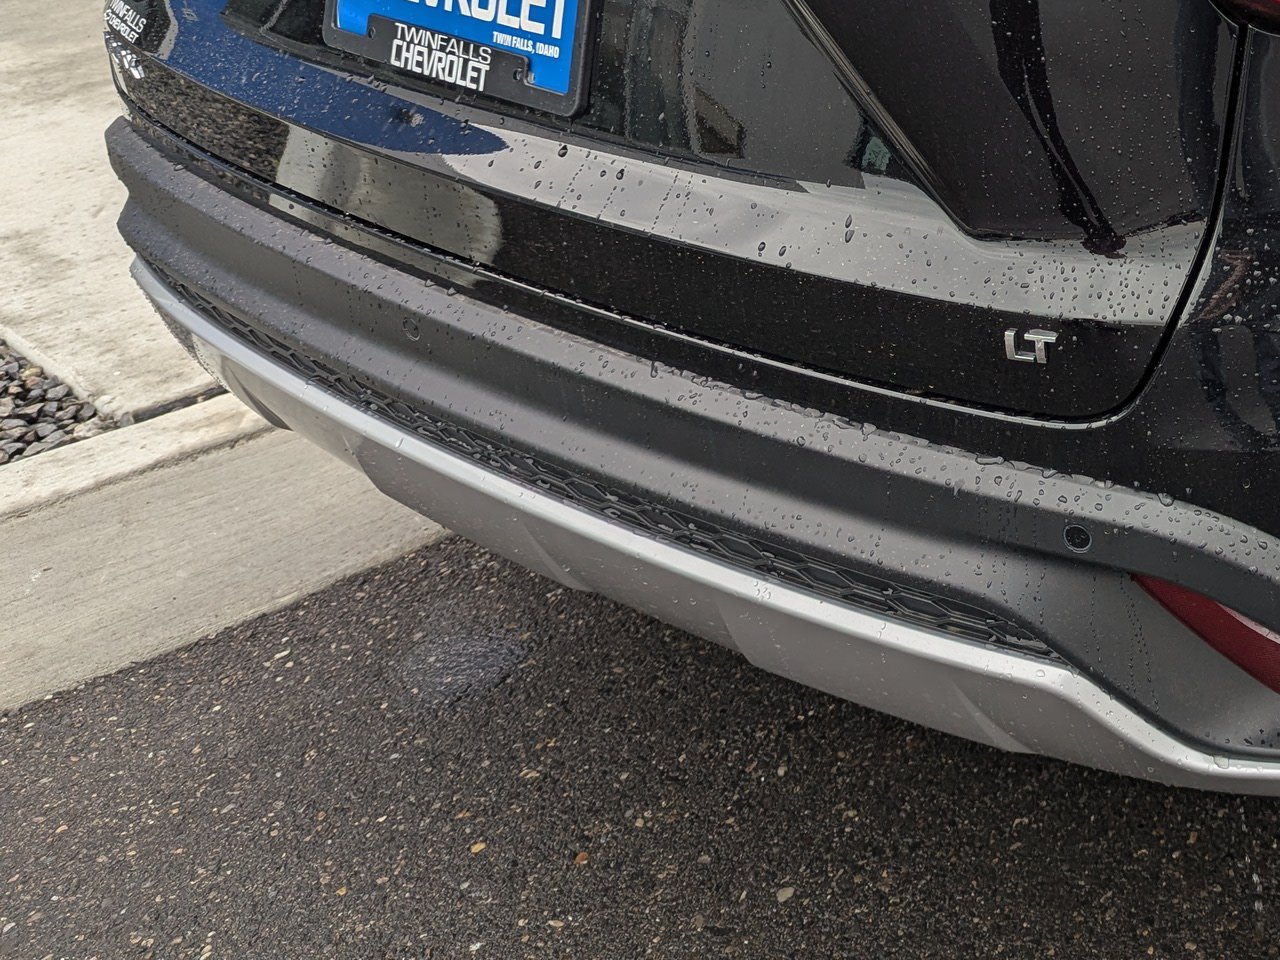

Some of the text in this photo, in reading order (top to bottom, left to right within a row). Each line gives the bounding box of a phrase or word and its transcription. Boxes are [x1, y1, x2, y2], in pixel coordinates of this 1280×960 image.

[492, 31, 560, 59] TWIN FALLS, IDAHO
[390, 38, 490, 92] CHEVROLET
[1004, 327, 1059, 364] LT
